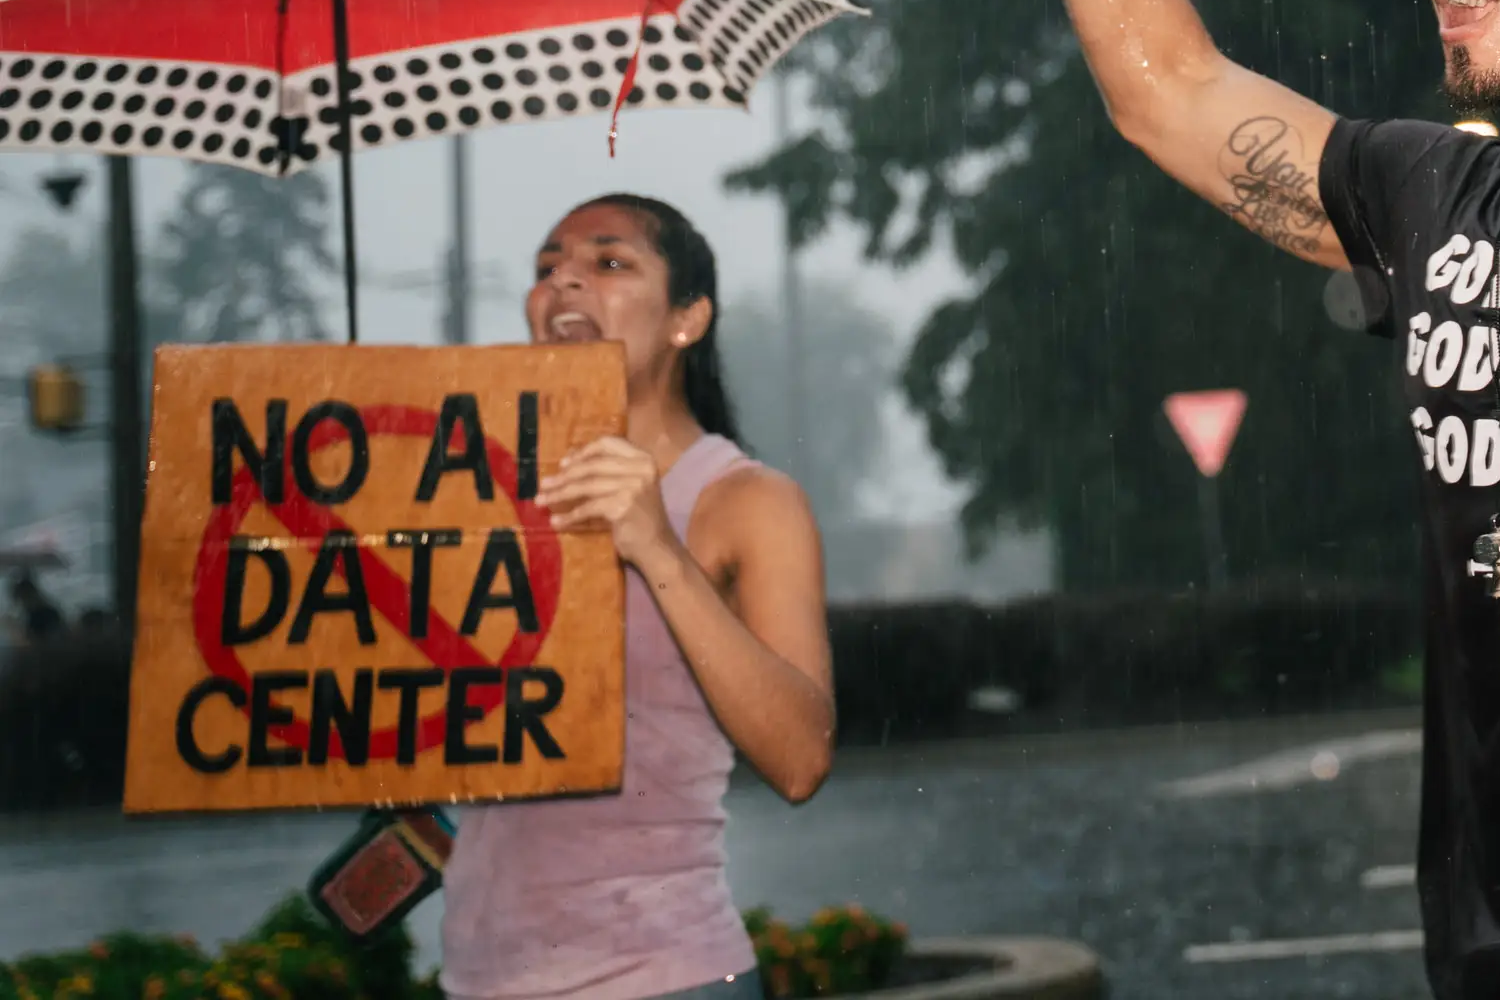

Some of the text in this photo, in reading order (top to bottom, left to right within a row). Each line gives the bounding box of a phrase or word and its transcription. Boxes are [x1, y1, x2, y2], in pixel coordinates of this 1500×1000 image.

[211, 392, 539, 506] NO AI
[221, 530, 539, 646] DATA
[176, 667, 566, 774] CENTER
